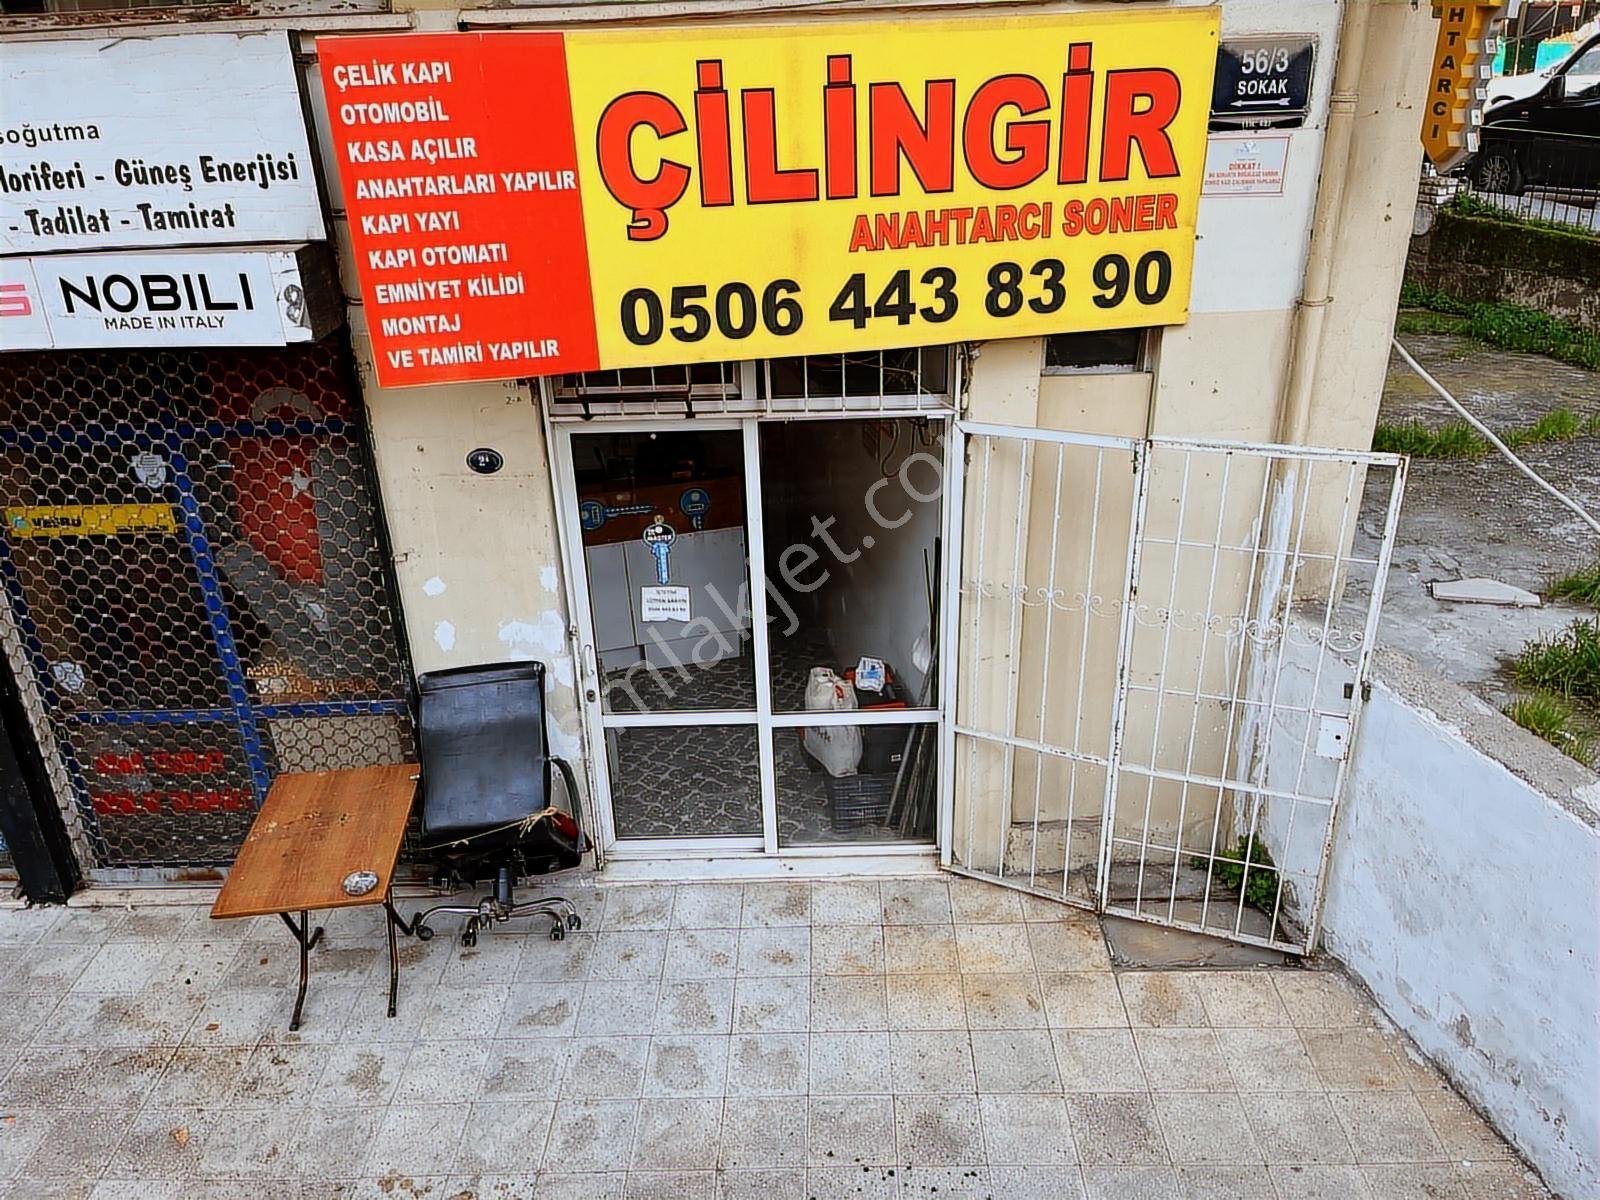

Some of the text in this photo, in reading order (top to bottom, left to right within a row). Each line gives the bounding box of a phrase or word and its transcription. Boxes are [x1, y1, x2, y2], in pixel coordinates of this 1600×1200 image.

[333, 59, 452, 92] ÇELİK KAPI
[1241, 47, 1289, 76] 56/3
[1237, 79, 1288, 95] SOKAK
[340, 95, 449, 125] OTOMOBİL
[347, 137, 478, 165] KASA AÇILIR
[596, 42, 1181, 242] ÇİLİNGİR
[114, 158, 193, 192] Güneş
[199, 152, 299, 189] Enerjisi
[356, 170, 576, 199] ANAHTARLARI YAPILIR
[25, 206, 110, 236] Tadilat
[136, 202, 236, 231] Tamirat
[361, 211, 461, 235] KAPI YAYI
[849, 193, 1178, 253] ANAHTARCI SONER
[368, 243, 508, 269] KAPI OTOMATI
[58, 273, 254, 314] NOBILI
[375, 271, 525, 304] EMNİYET KİLİDİ
[619, 249, 1173, 347] 0506 443 83 90
[105, 315, 225, 330] MADE IN ITALY
[381, 313, 461, 337] MONTAJ
[387, 339, 560, 369] VE TAMİRİ YAPILIR
